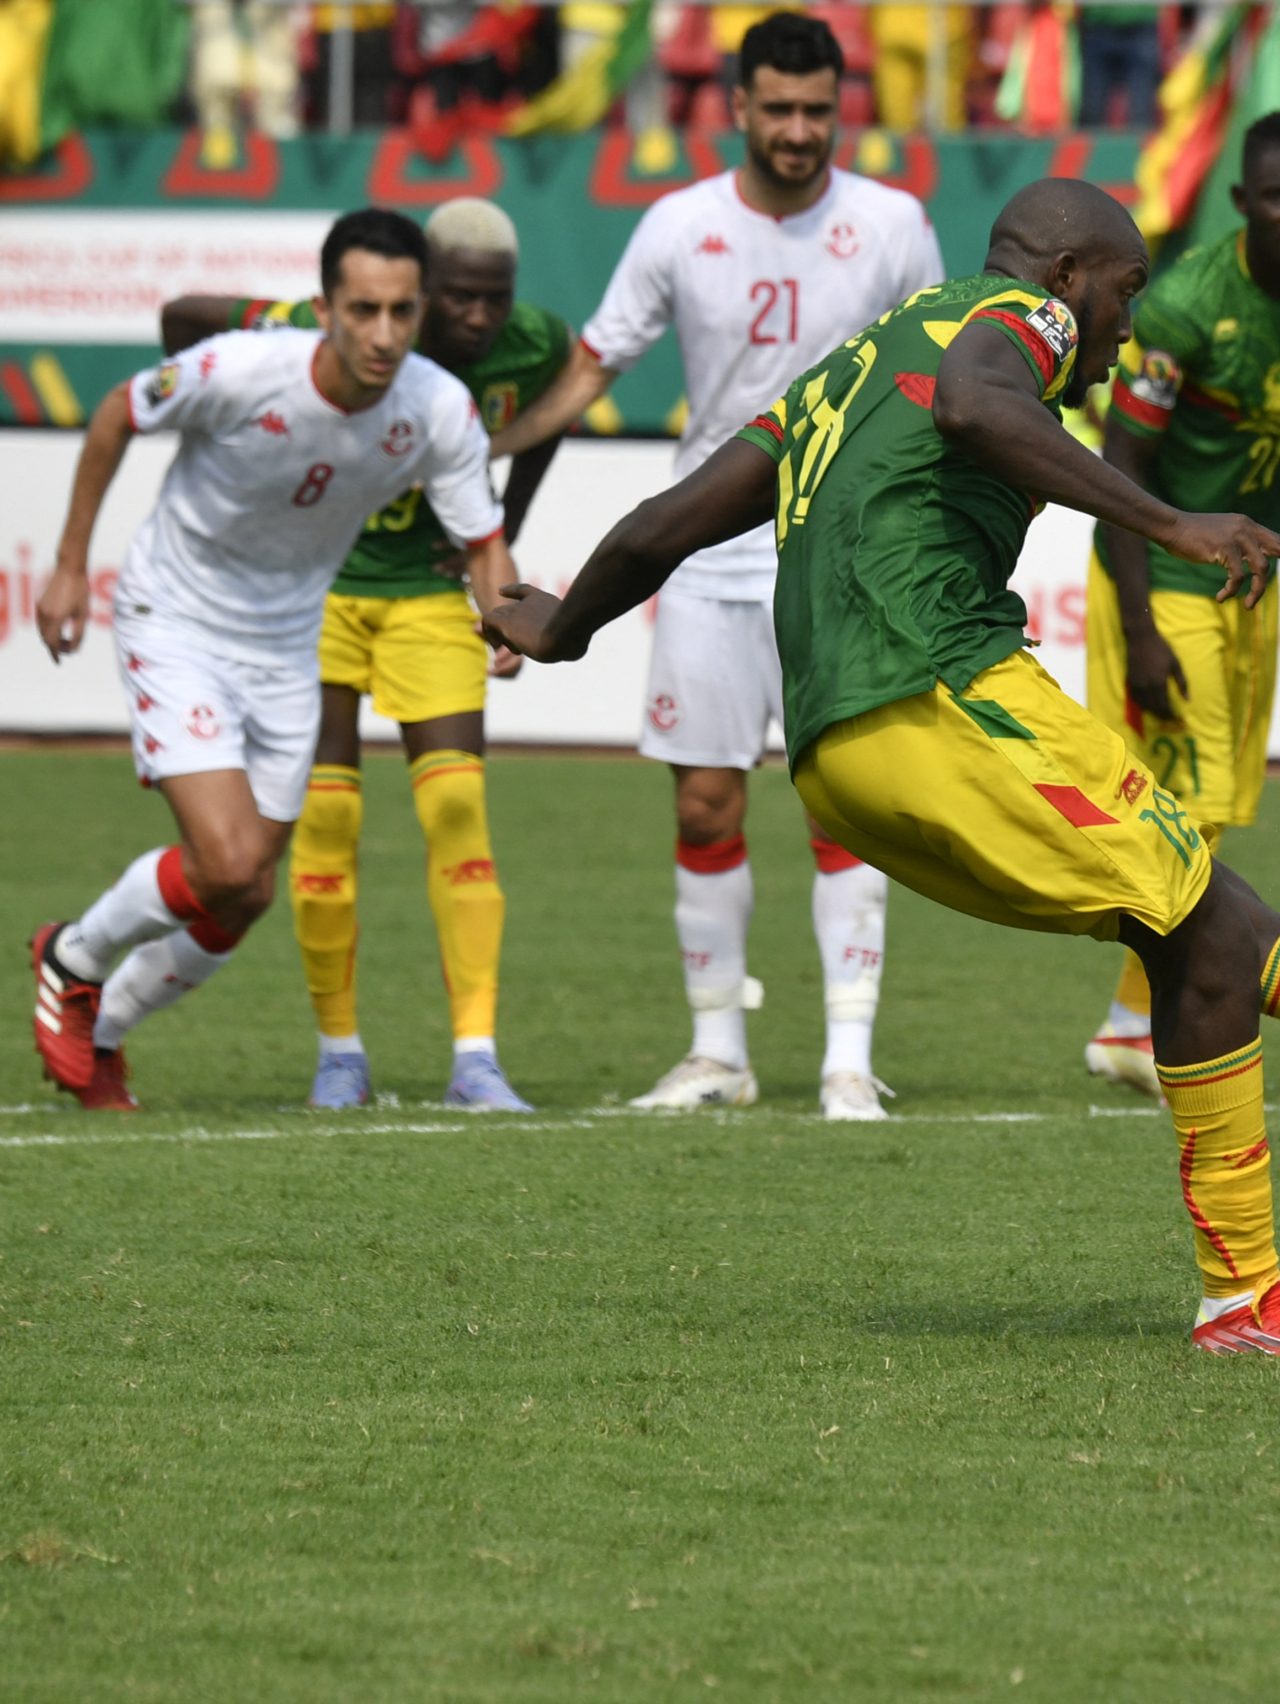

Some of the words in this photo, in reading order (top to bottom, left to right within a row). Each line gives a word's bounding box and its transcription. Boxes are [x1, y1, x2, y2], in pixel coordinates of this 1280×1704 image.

[749, 278, 799, 345] 21
[777, 338, 877, 552] 18
[292, 463, 334, 509] 8
[365, 484, 423, 532] 9
[1152, 734, 1201, 799] 21
[1138, 788, 1201, 870] 18
